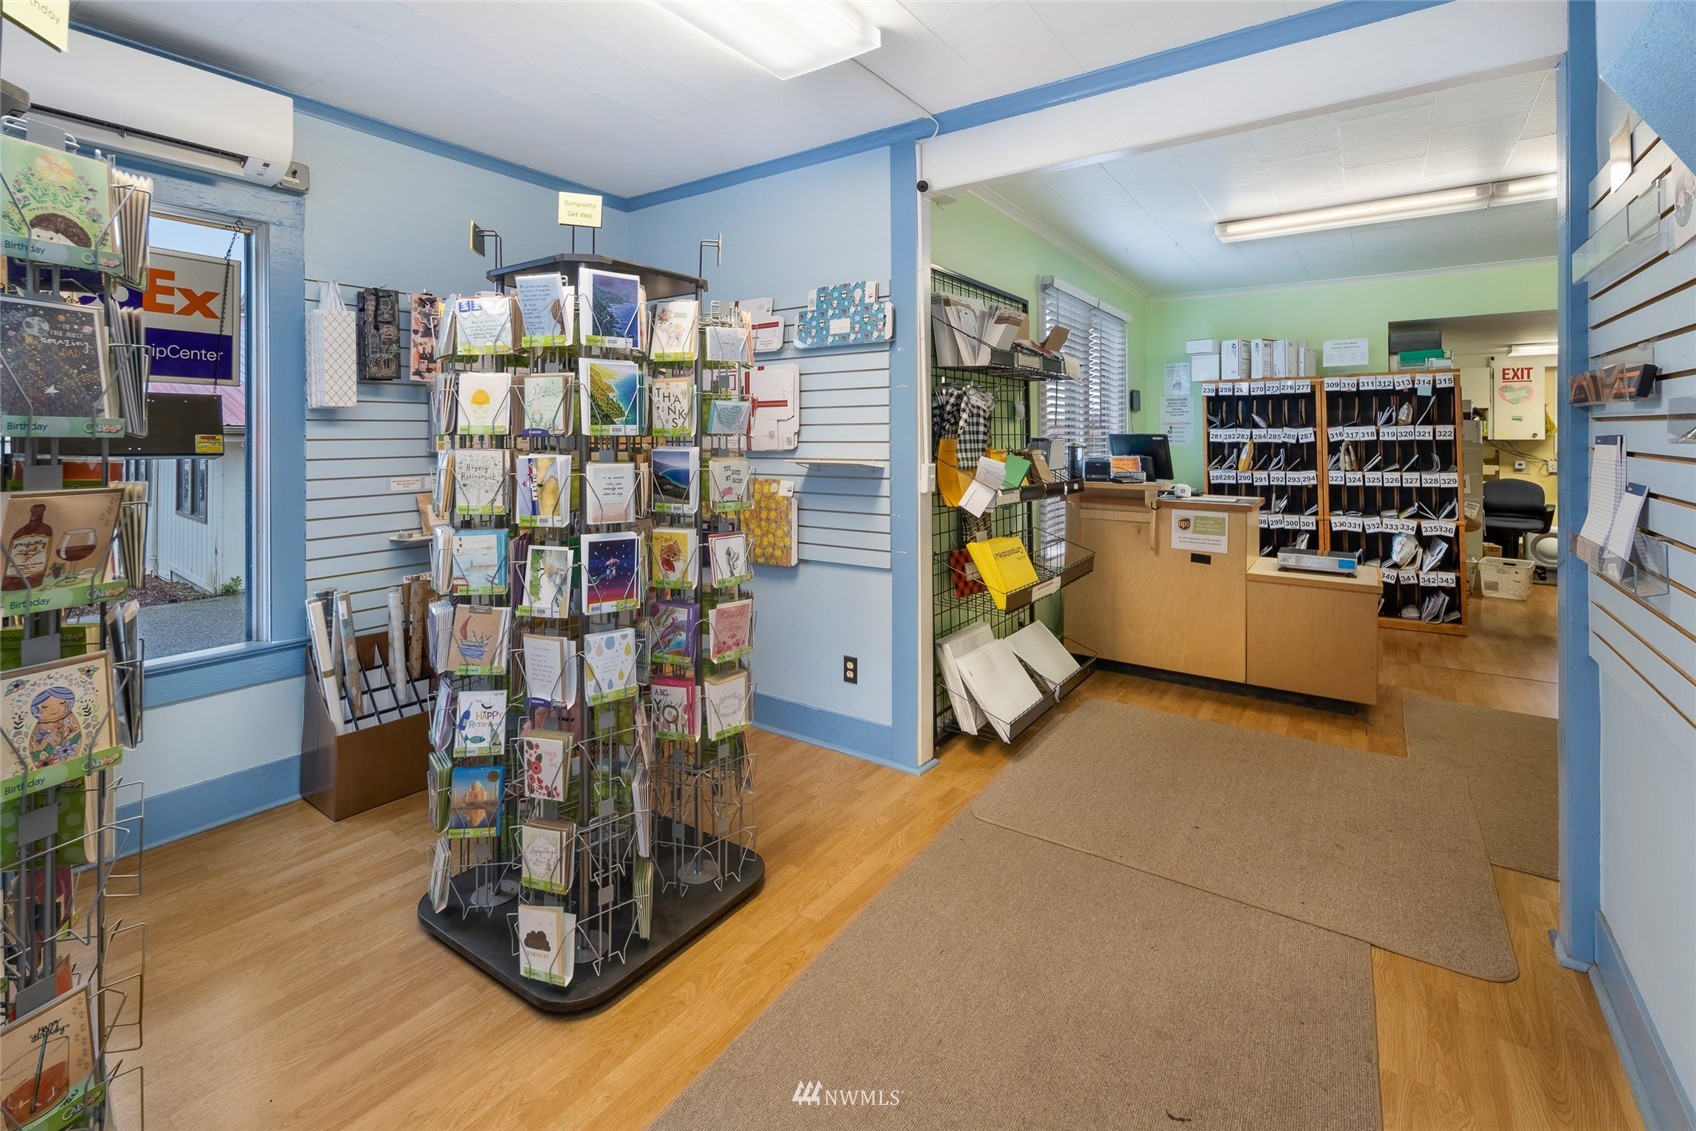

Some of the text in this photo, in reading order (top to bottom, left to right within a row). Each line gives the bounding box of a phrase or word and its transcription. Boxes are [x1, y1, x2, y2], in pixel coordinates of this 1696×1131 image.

[564, 199, 597, 209] Sympathy
[567, 210, 578, 218] Get
[65, 331, 84, 339] MOST
[40, 336, 92, 354] amazing
[61, 349, 81, 358] DAD
[151, 343, 224, 362] ipCenter
[1501, 367, 1533, 381] EXIT
[1325, 381, 1339, 389] 309
[1341, 381, 1356, 389] 310
[1360, 380, 1375, 388] 311
[1376, 380, 1392, 388] 312
[1395, 379, 1411, 387] 313
[1415, 378, 1431, 386] 314
[1437, 377, 1453, 385] 315
[1202, 386, 1215, 394] 239
[1251, 385, 1264, 393] 270
[6, 421, 48, 433] Birthday
[1236, 432, 1249, 440] 283
[1282, 432, 1296, 440] 286
[1329, 430, 1344, 439] 316
[1344, 431, 1359, 439] 317
[1360, 430, 1375, 438] 318
[1380, 430, 1395, 438] 319
[1398, 430, 1413, 438] 320
[1416, 430, 1431, 438] 321
[1423, 477, 1439, 485] 328
[1441, 476, 1458, 485] 329
[1178, 520, 1190, 529] ups
[1332, 521, 1347, 529] 330
[1365, 522, 1381, 530] 332
[1383, 523, 1399, 531] 333
[1399, 523, 1415, 532] 334
[1422, 525, 1439, 533] 335
[1382, 572, 1396, 581] 340
[1420, 576, 1437, 584] 342
[1438, 576, 1455, 585] 343
[475, 710, 504, 720] HAPPY
[526, 950, 549, 960] SYMPATHY
